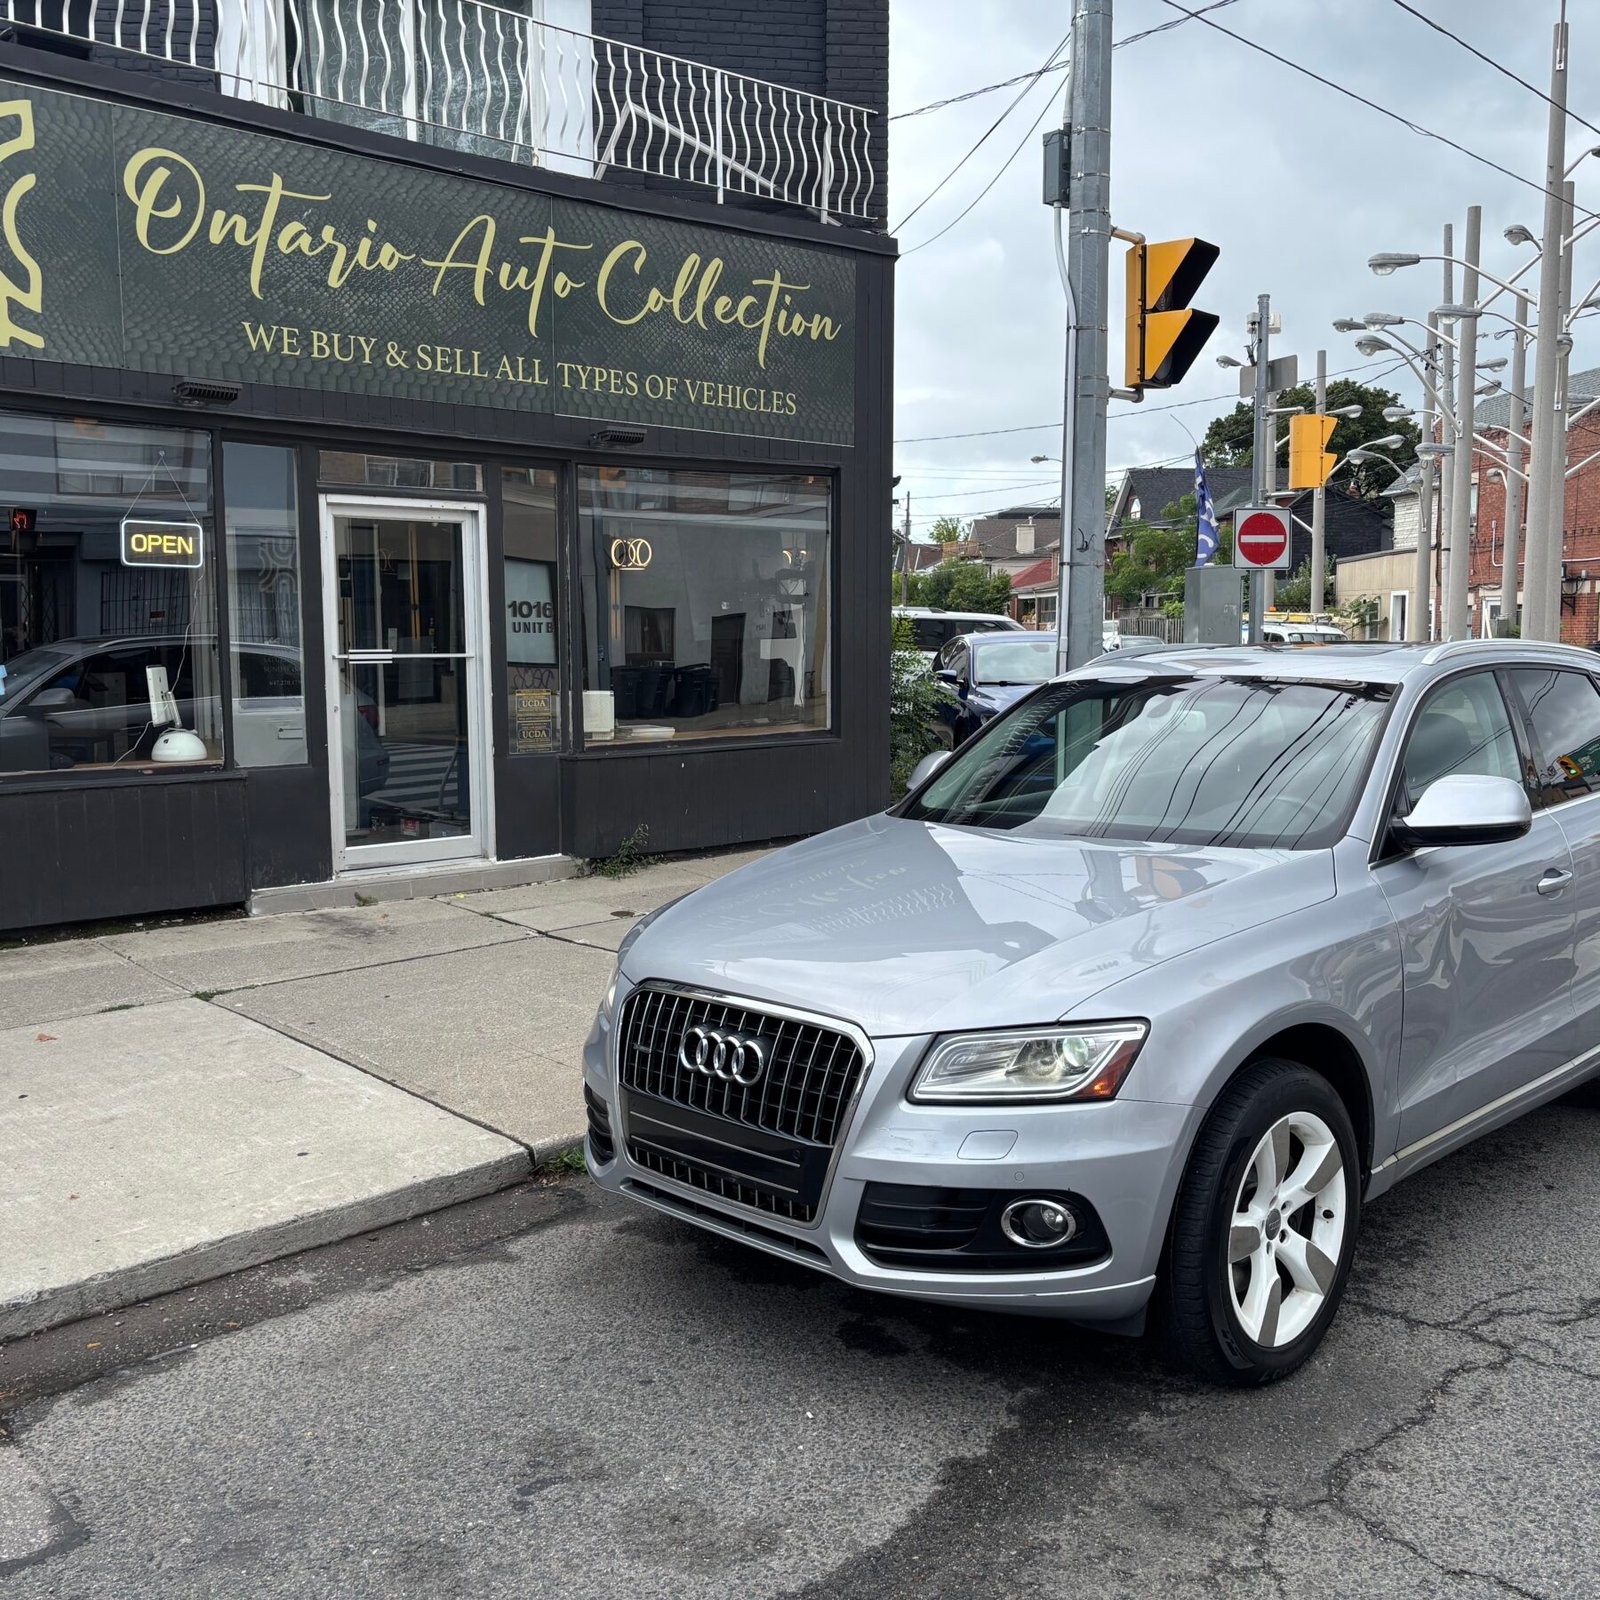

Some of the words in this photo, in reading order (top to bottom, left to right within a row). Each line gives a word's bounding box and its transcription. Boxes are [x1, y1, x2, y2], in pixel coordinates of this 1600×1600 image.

[123, 147, 415, 299] Ontario
[421, 214, 593, 338] Auto
[597, 240, 841, 370] Collection
[241, 321, 301, 356] WE
[310, 330, 378, 364] BUY
[385, 341, 410, 368] &
[416, 344, 489, 377] SELL
[495, 354, 549, 385] ALL
[556, 362, 639, 396] TYPES
[645, 374, 679, 401] OF
[684, 379, 797, 415] VEHICLES
[131, 534, 193, 554] OPEN
[508, 600, 554, 618] 1016
[512, 621, 543, 633] UNIT
[522, 699, 546, 708] UCDA
[522, 730, 547, 739] UCDA
